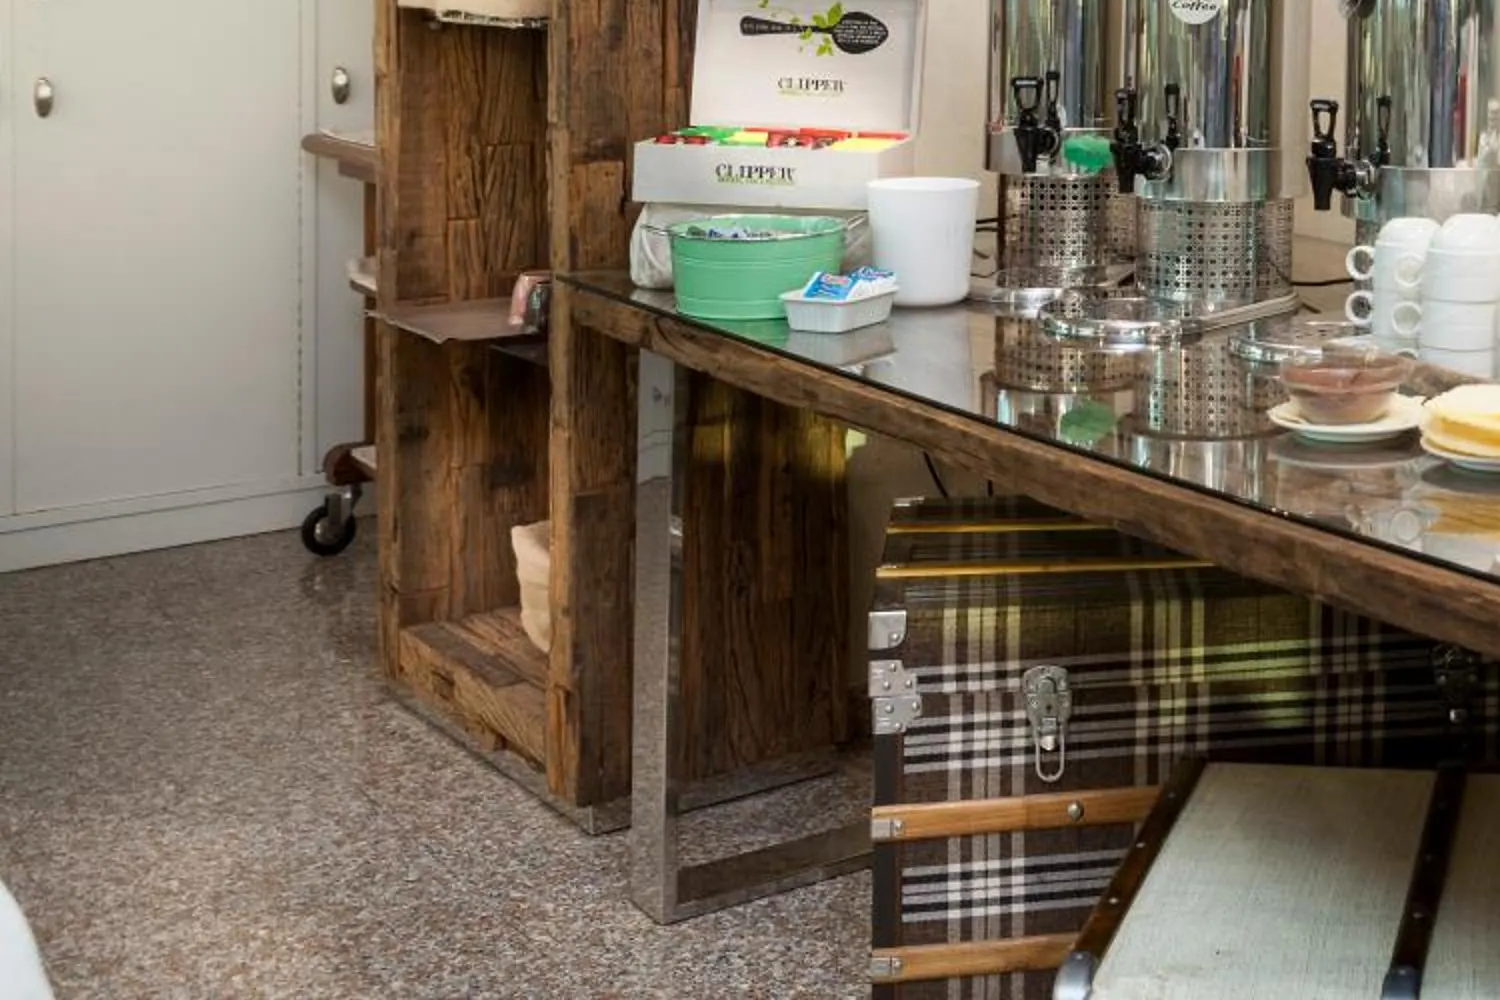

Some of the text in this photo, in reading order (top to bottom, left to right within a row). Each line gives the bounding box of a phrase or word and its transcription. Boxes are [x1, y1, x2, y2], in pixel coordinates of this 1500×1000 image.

[1171, 1, 1217, 11] Coffee
[777, 76, 843, 92] CLIPPER
[715, 162, 796, 181] CLIPPER
